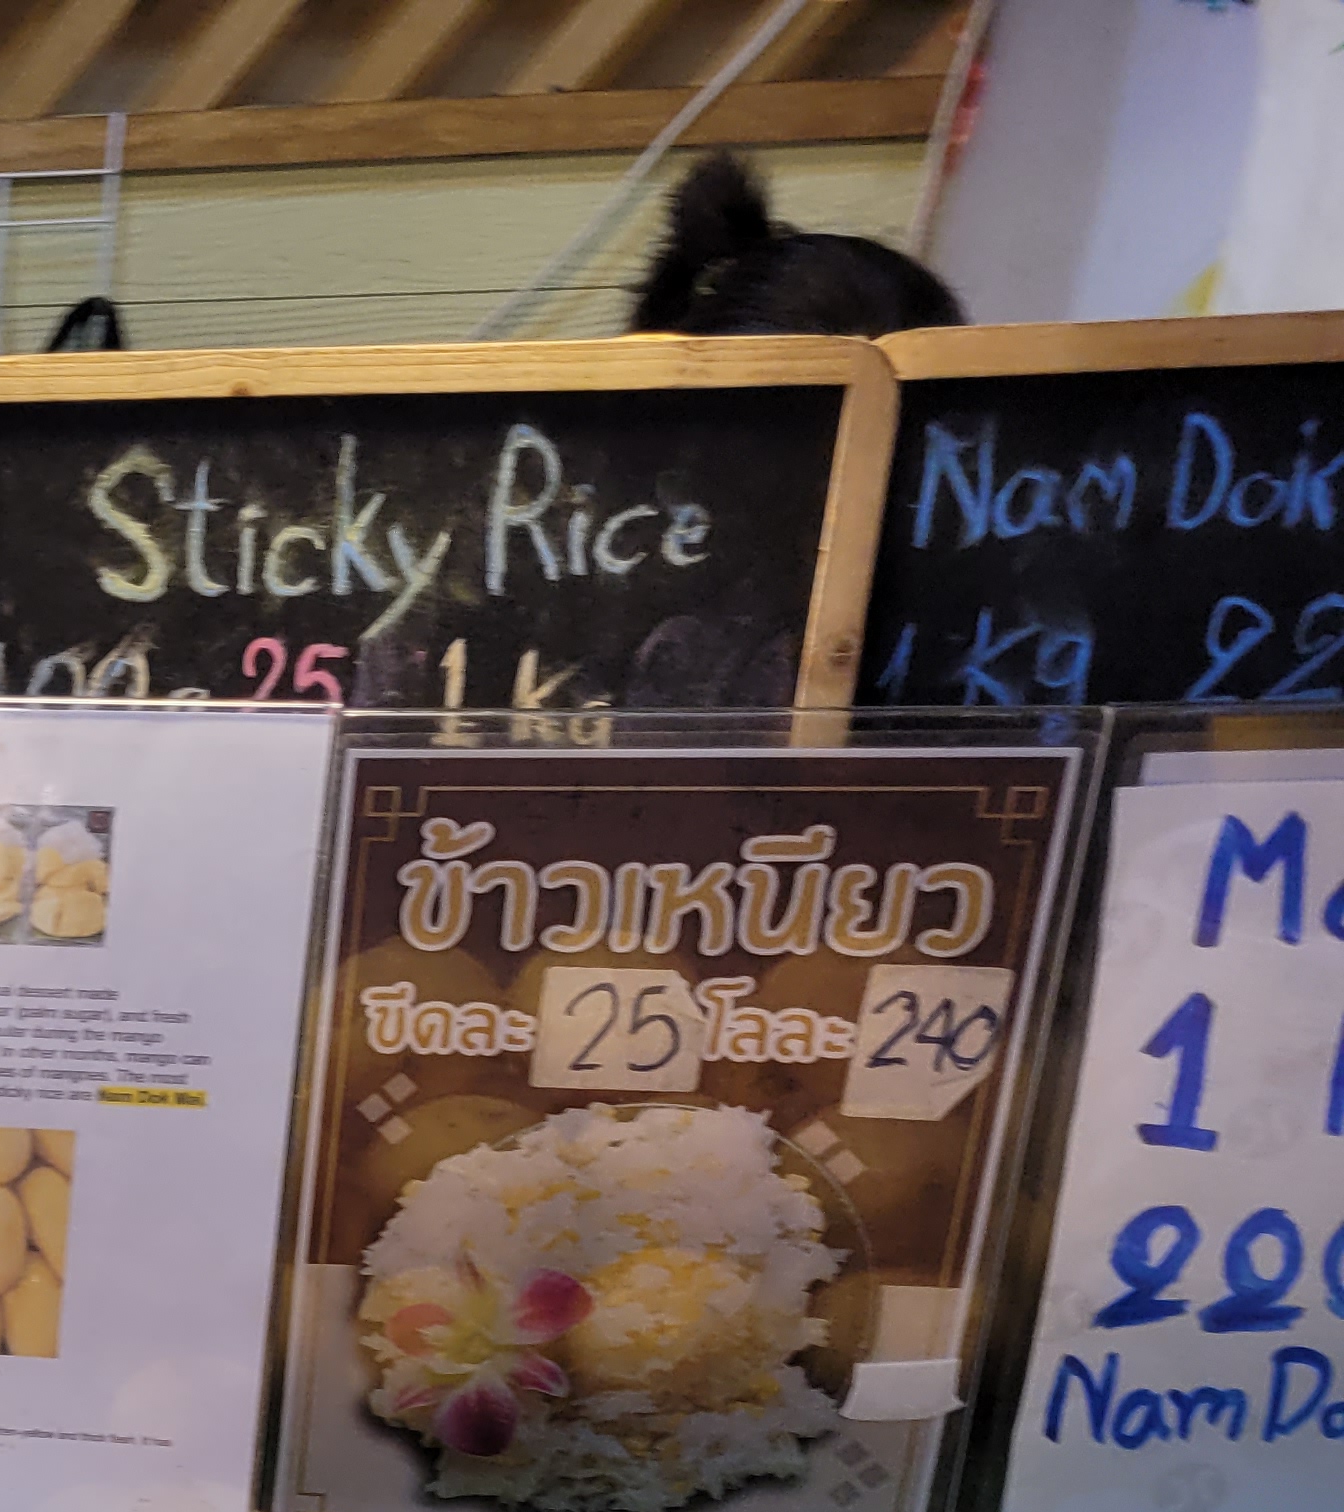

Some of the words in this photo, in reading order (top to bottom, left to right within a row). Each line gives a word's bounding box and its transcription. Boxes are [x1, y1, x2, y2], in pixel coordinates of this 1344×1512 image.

[88, 433, 451, 640] Sticky
[485, 423, 710, 597] Rice
[911, 414, 1136, 548] Nam
[427, 637, 482, 748] 1
[398, 818, 996, 958] ข้าวเหนียว
[1195, 811, 1344, 947] M
[361, 980, 536, 1056] ขีดละ
[562, 982, 682, 1074] 25
[863, 989, 1001, 1074] 240
[1136, 991, 1220, 1152] 1
[1043, 1352, 1248, 1450] Nam
